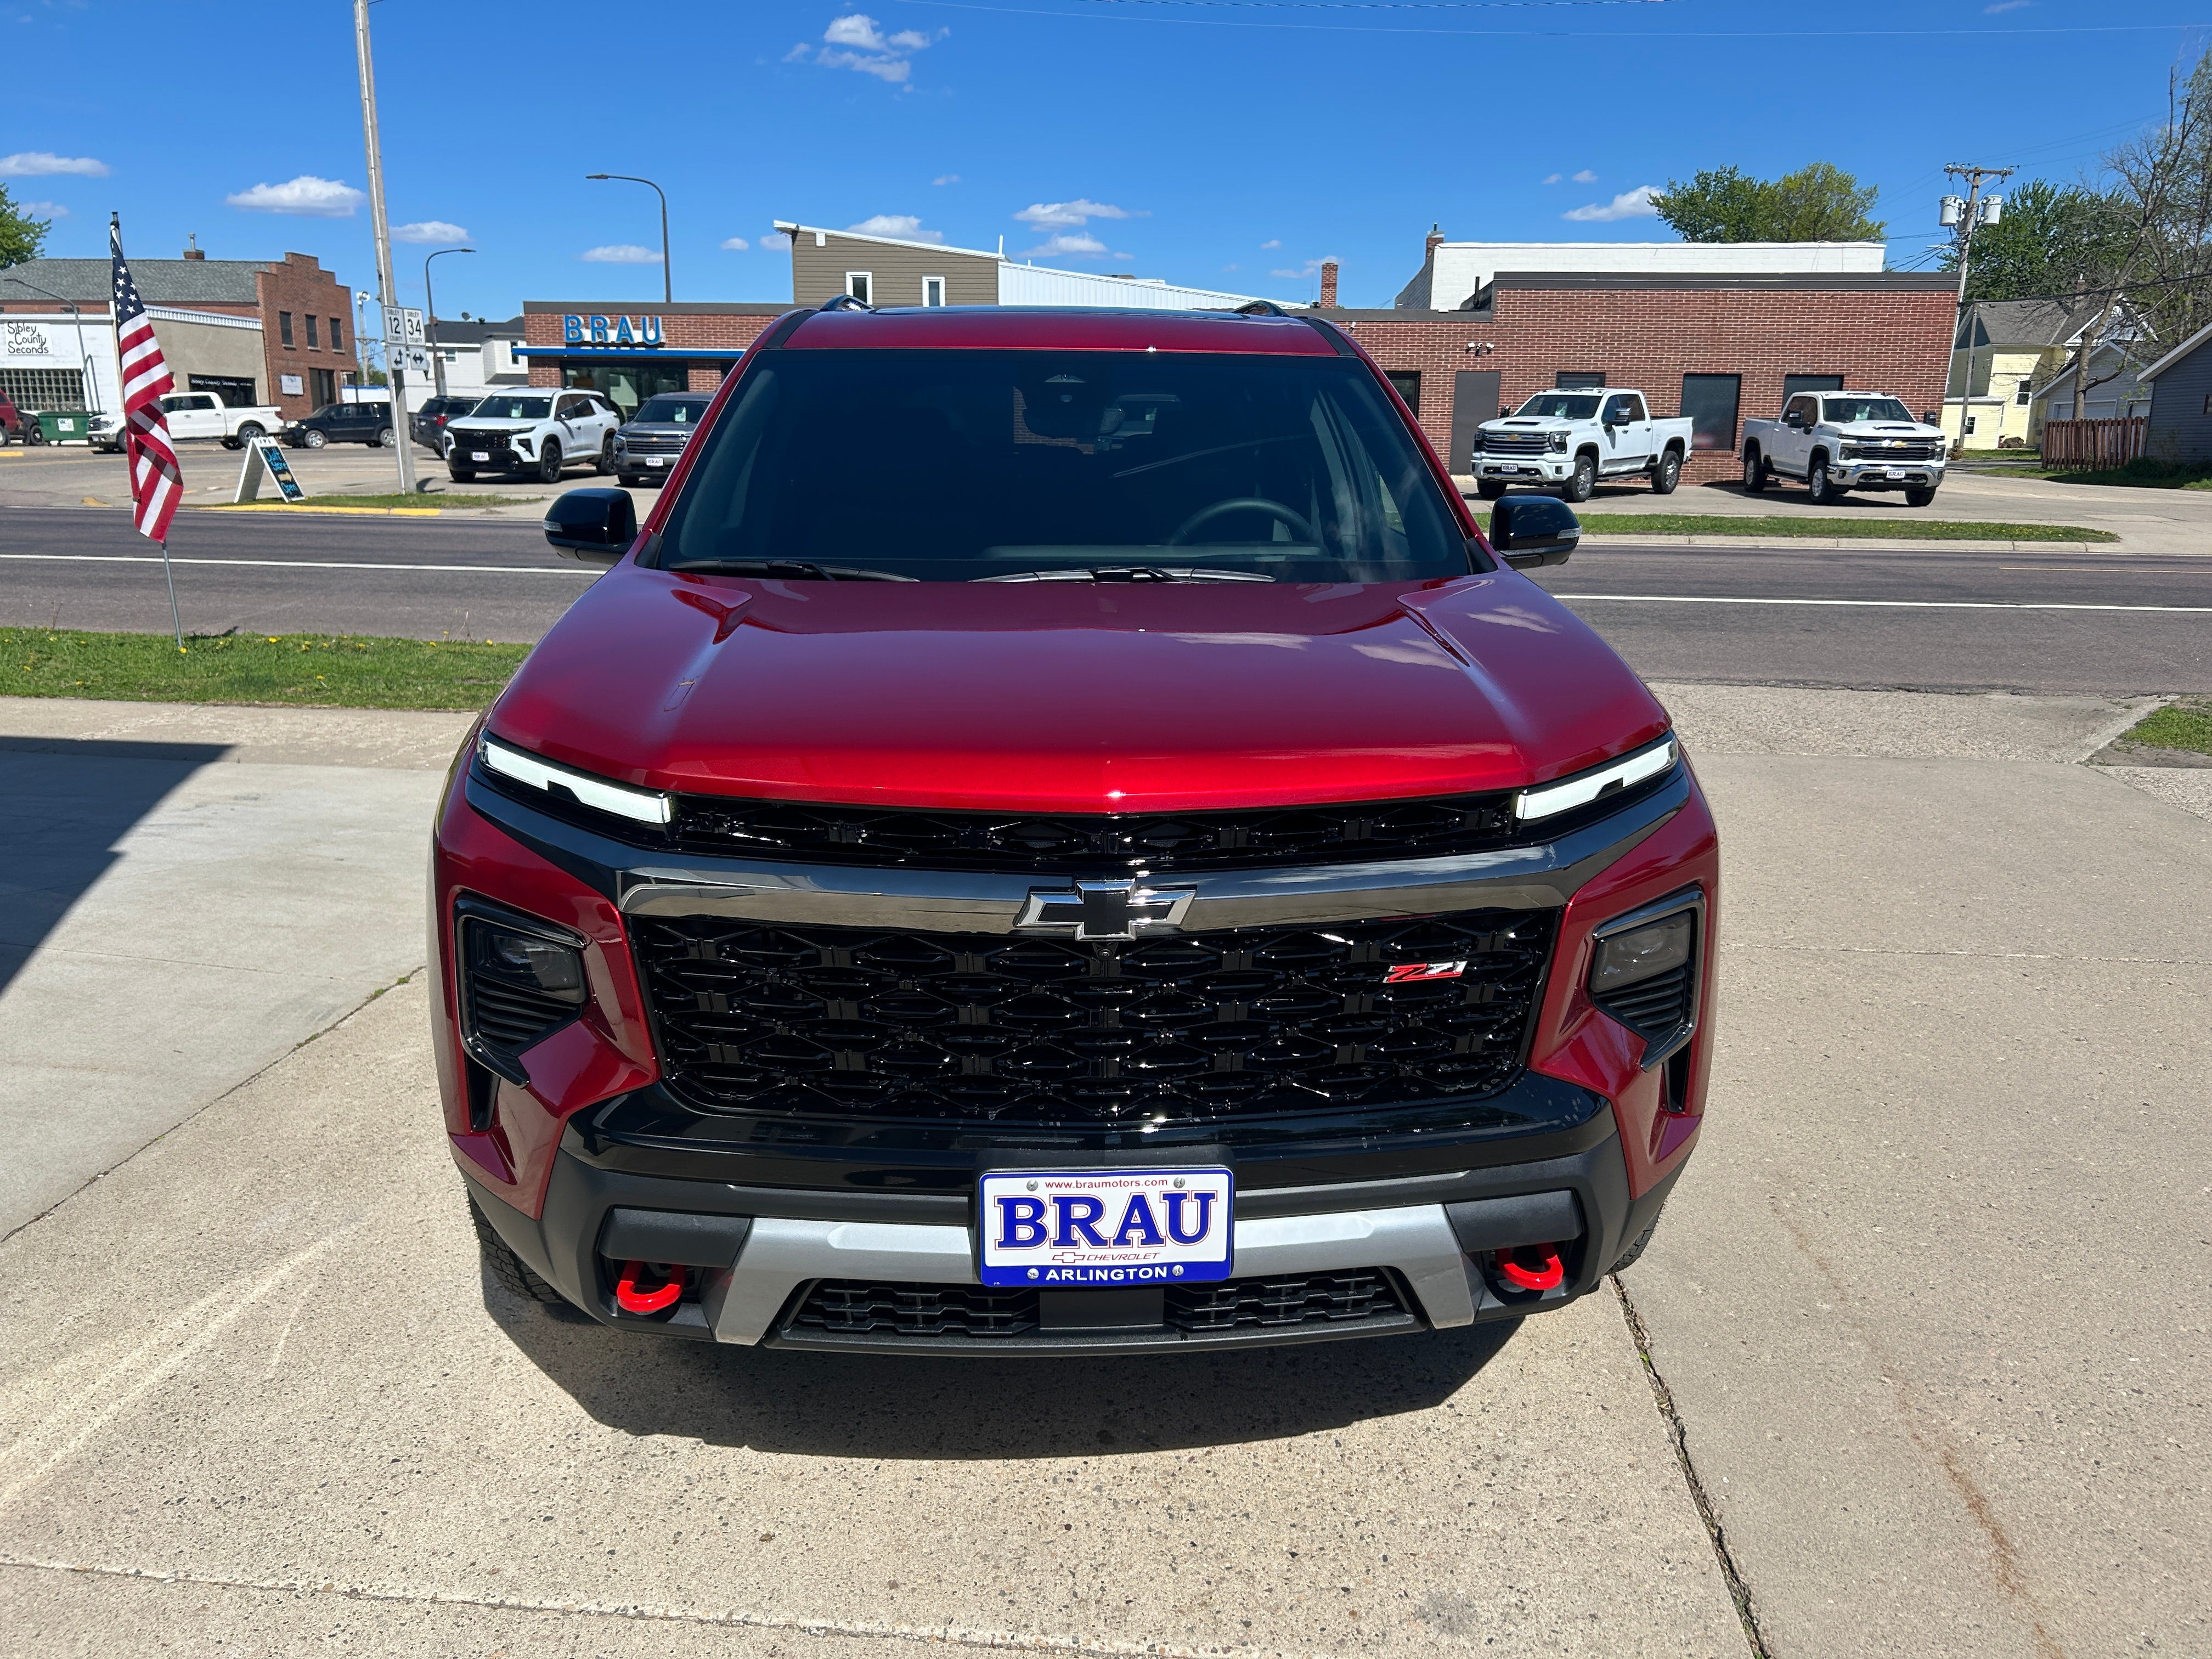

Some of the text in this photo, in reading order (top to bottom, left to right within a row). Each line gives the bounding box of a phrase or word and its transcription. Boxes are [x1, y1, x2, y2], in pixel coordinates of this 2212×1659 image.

[7, 321, 37, 336] Sibley
[389, 316, 400, 334] 12
[408, 318, 421, 336] 34
[563, 314, 663, 345] BRAU
[14, 332, 47, 347] County
[8, 341, 49, 354] Seconds
[1383, 961, 1468, 983] Z71
[1045, 1178, 1168, 1189] www.braumotors.com
[994, 1189, 1218, 1251] BRAU
[1087, 1252, 1160, 1261] CHEVROLET
[1045, 1266, 1167, 1281] ARLINGTON
